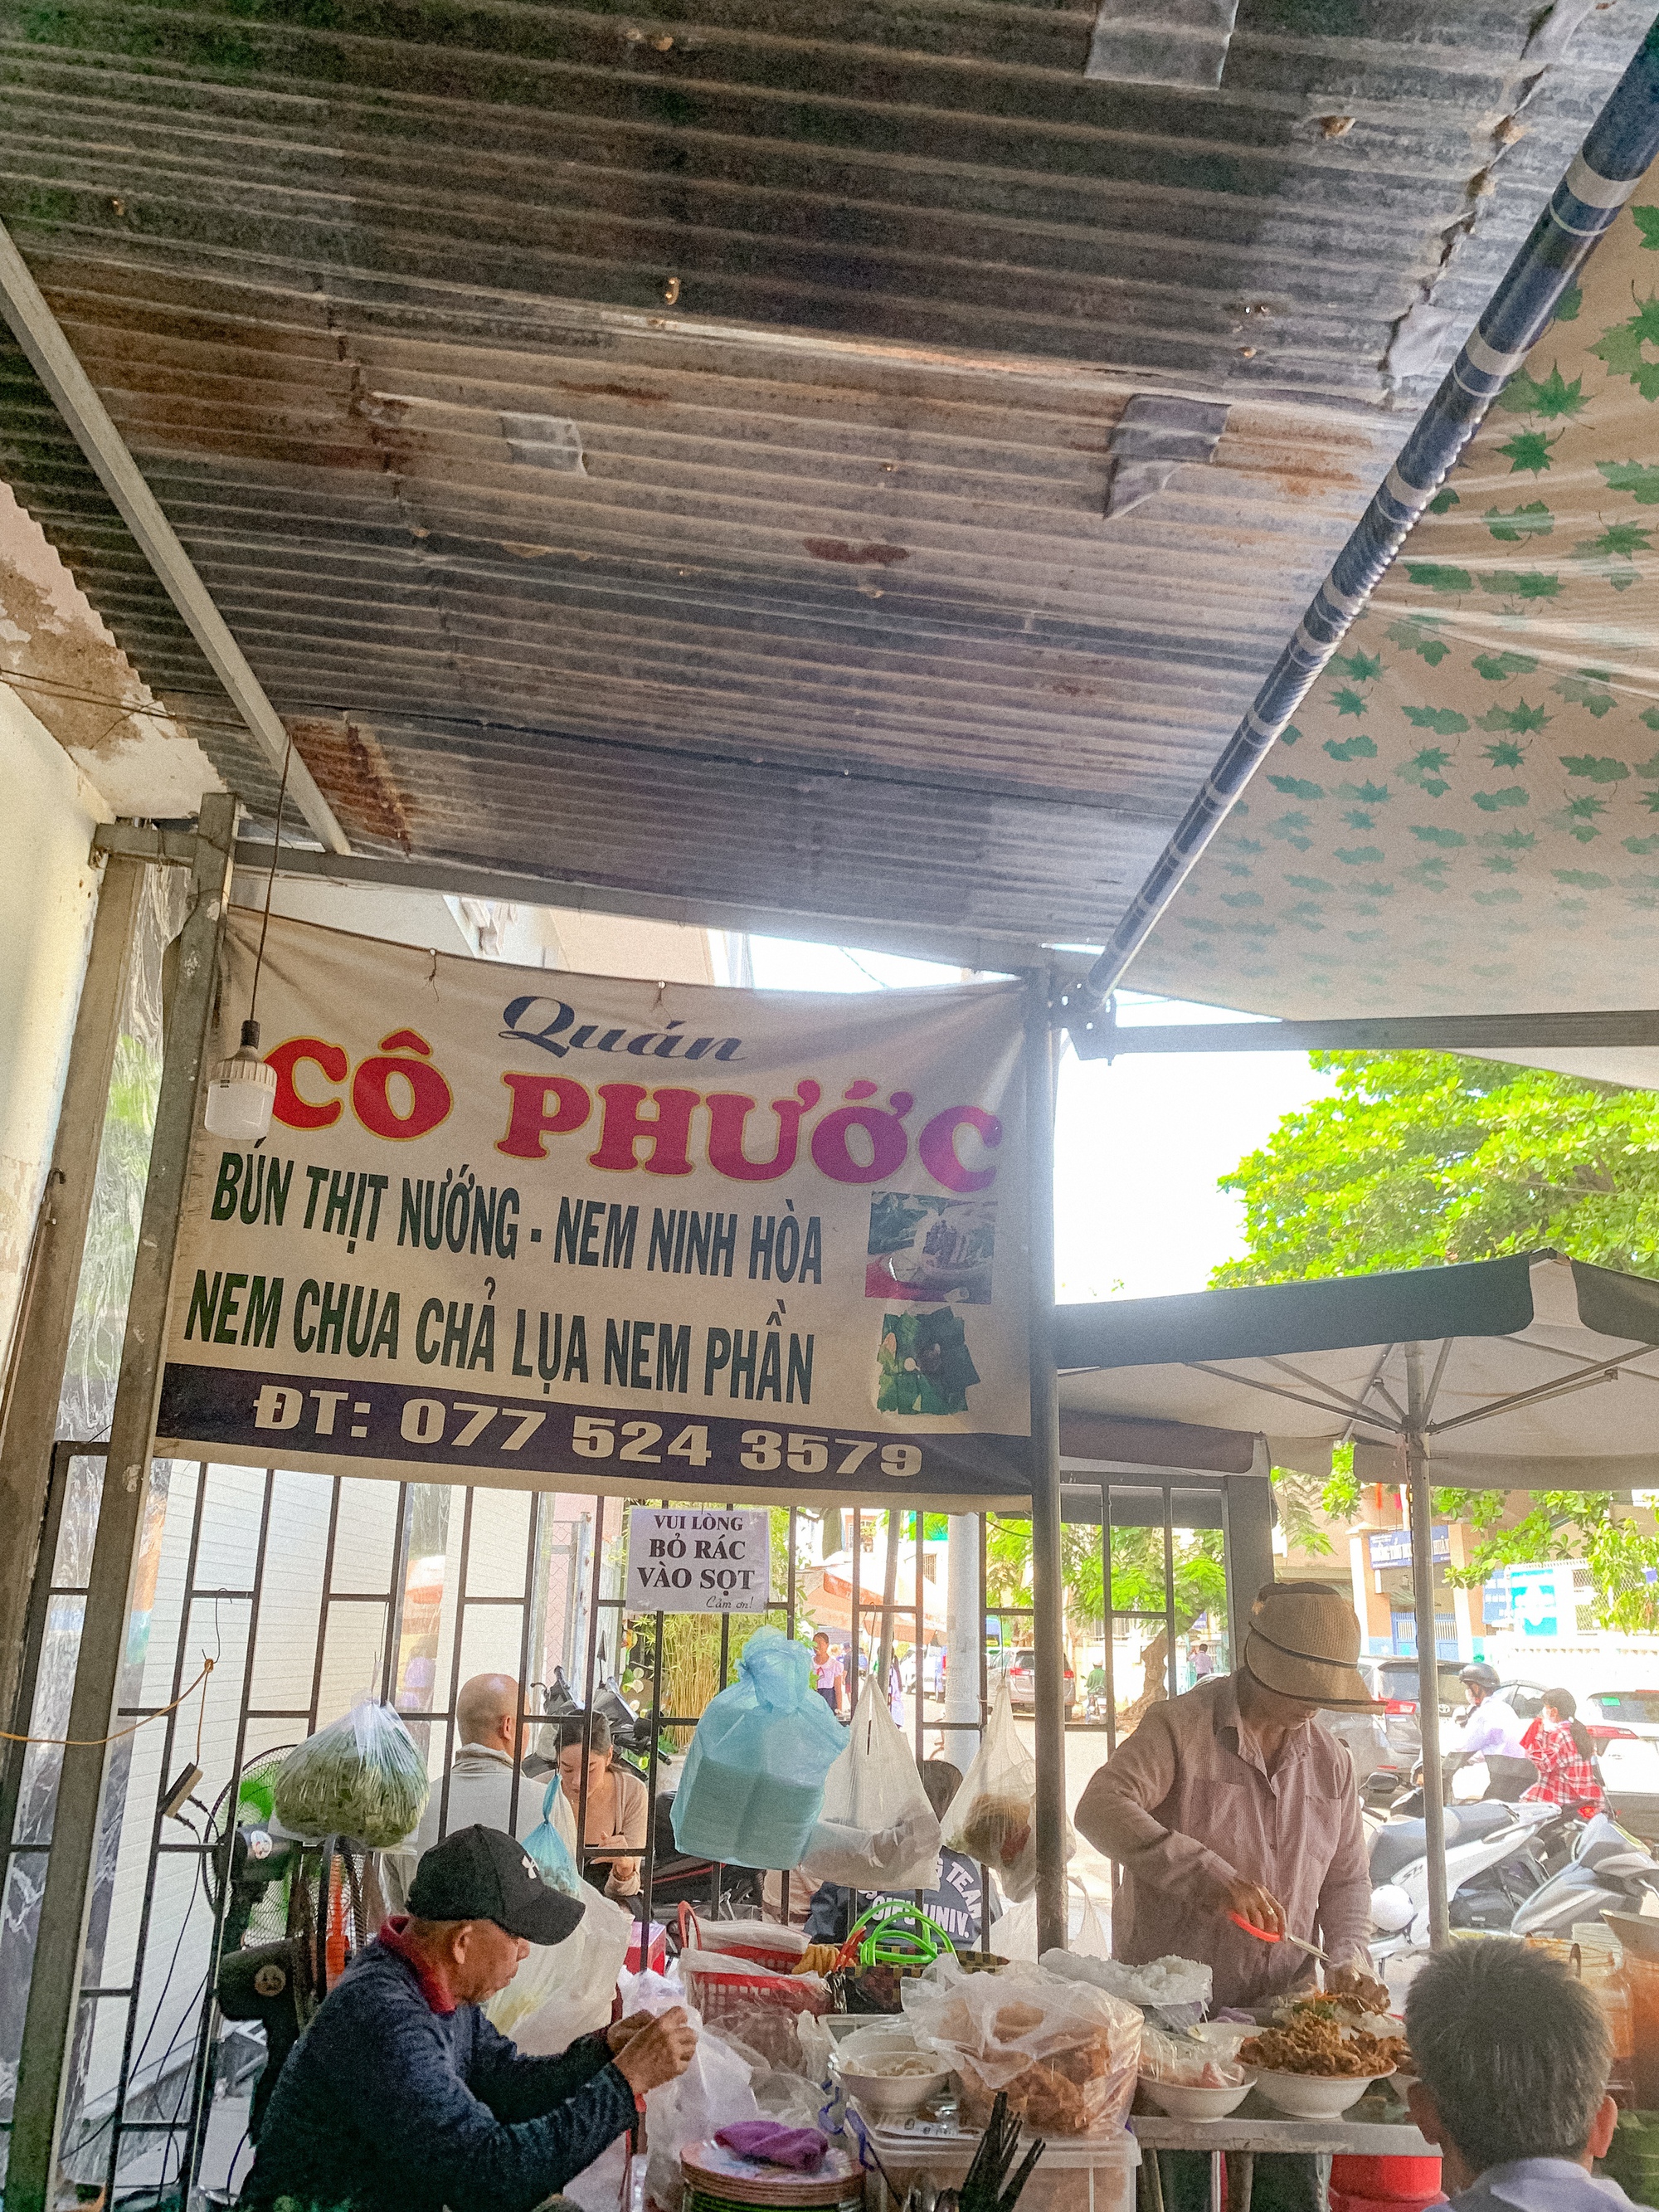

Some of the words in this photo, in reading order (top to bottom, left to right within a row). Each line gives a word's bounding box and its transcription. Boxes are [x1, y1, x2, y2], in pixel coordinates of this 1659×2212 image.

[498, 996, 747, 1061] Quán
[261, 1028, 454, 1141] CÔ
[494, 1070, 1003, 1193] PHƯỚC
[210, 1137, 294, 1226] BÚN
[303, 1166, 388, 1254] THỊT
[397, 1163, 520, 1259] NƯỚNG
[553, 1196, 639, 1269] NEM
[647, 1207, 738, 1278] NINH
[748, 1198, 822, 1284] HÒA
[184, 1269, 285, 1349] NEM
[294, 1279, 401, 1360] CHUA
[415, 1276, 495, 1372] CHẢ
[512, 1308, 589, 1394] LỤA
[604, 1318, 691, 1394] NEM
[703, 1299, 815, 1405] PHẦN
[253, 1385, 372, 1438] ĐT:
[400, 1398, 547, 1450] 077
[572, 1415, 713, 1466] 524
[740, 1430, 922, 1477] 3579
[649, 1532, 687, 1558] BỎ
[693, 1534, 746, 1560] RÁC
[654, 1515, 686, 1530] VUI
[692, 1513, 743, 1531] LÒNG
[637, 1561, 693, 1588] VÀO
[700, 1569, 755, 1596] SỌT
[706, 1596, 732, 1609] Cảm
